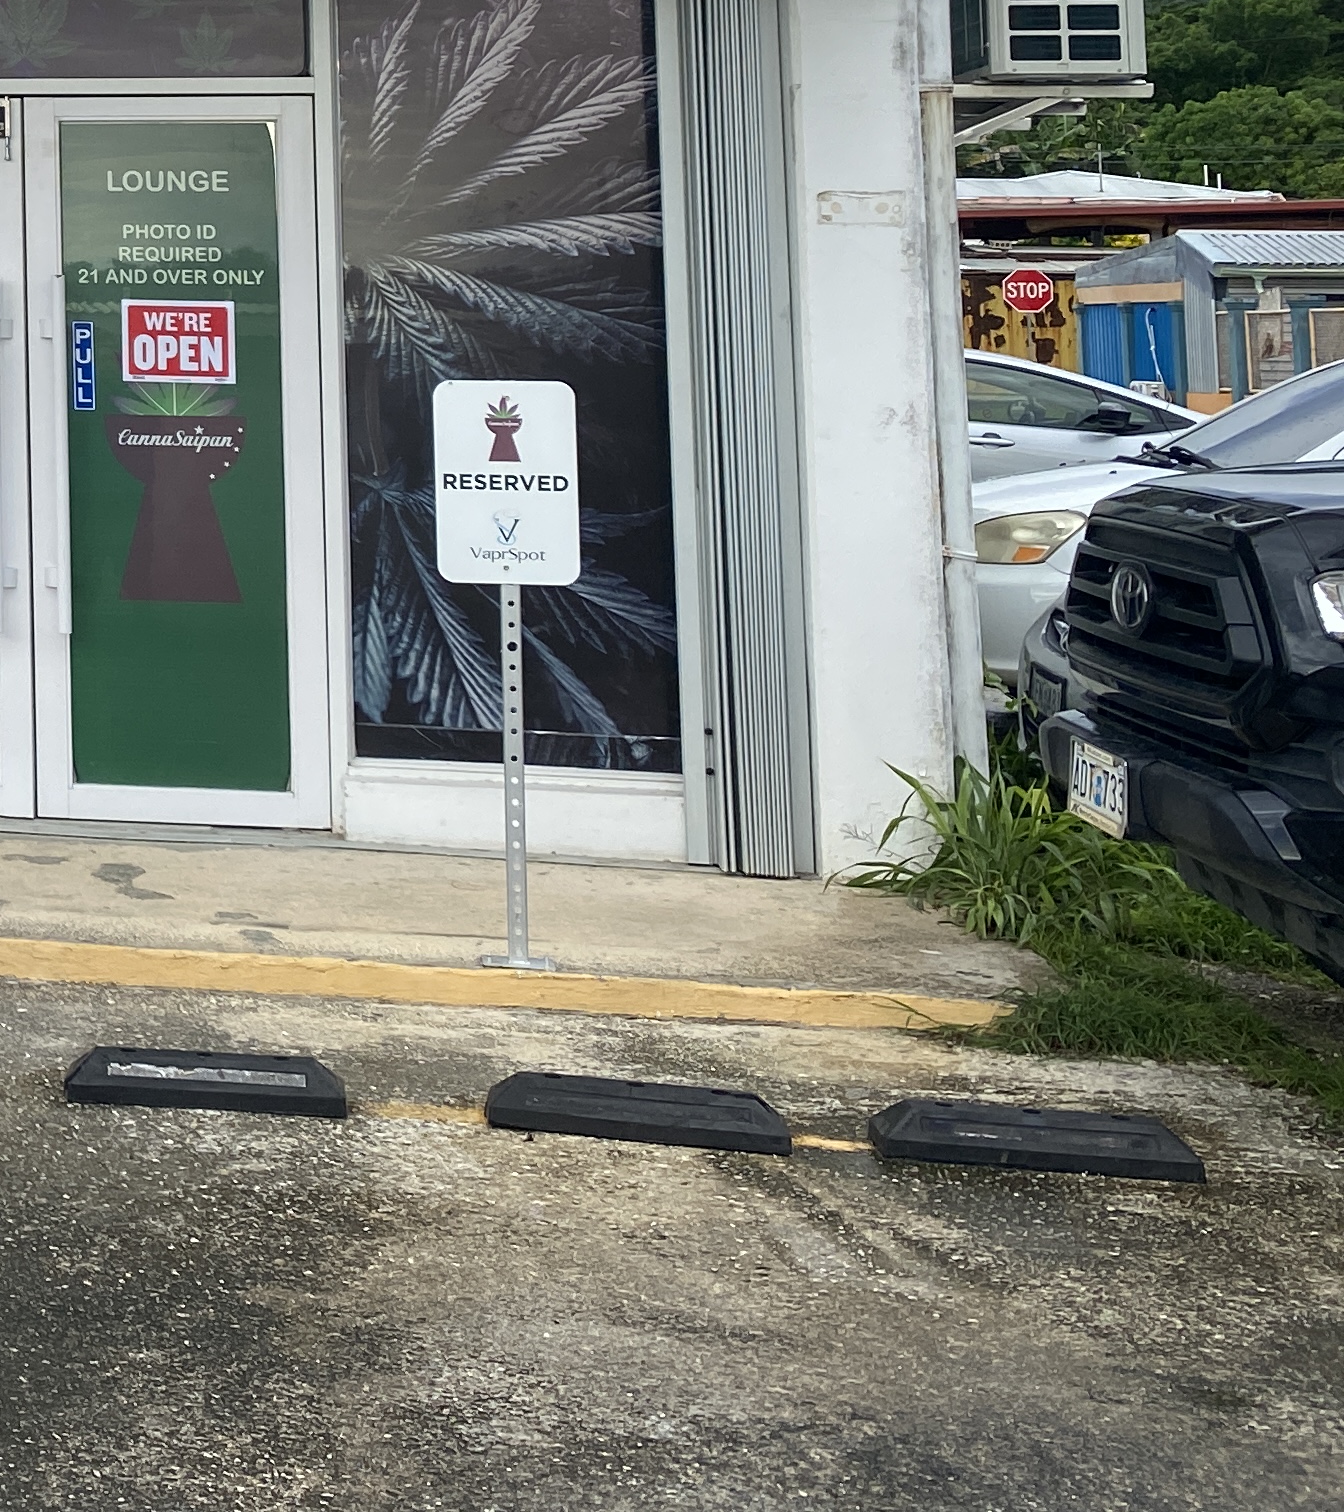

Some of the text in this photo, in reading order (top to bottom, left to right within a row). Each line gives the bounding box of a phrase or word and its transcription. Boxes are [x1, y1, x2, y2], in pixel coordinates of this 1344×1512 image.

[106, 170, 229, 193] LOUNGE
[122, 224, 216, 240] PHOTO ID
[118, 246, 222, 264] REQUIRED
[78, 268, 265, 286] 21 AND OVER ONLY
[1007, 281, 1050, 299] STOP
[143, 311, 212, 332] WE'RE
[133, 334, 223, 372] OPEN
[75, 328, 92, 404] PULL
[118, 427, 234, 453] CannaSaipan
[443, 473, 569, 492] RESERVED
[470, 546, 546, 563] VaprSpot
